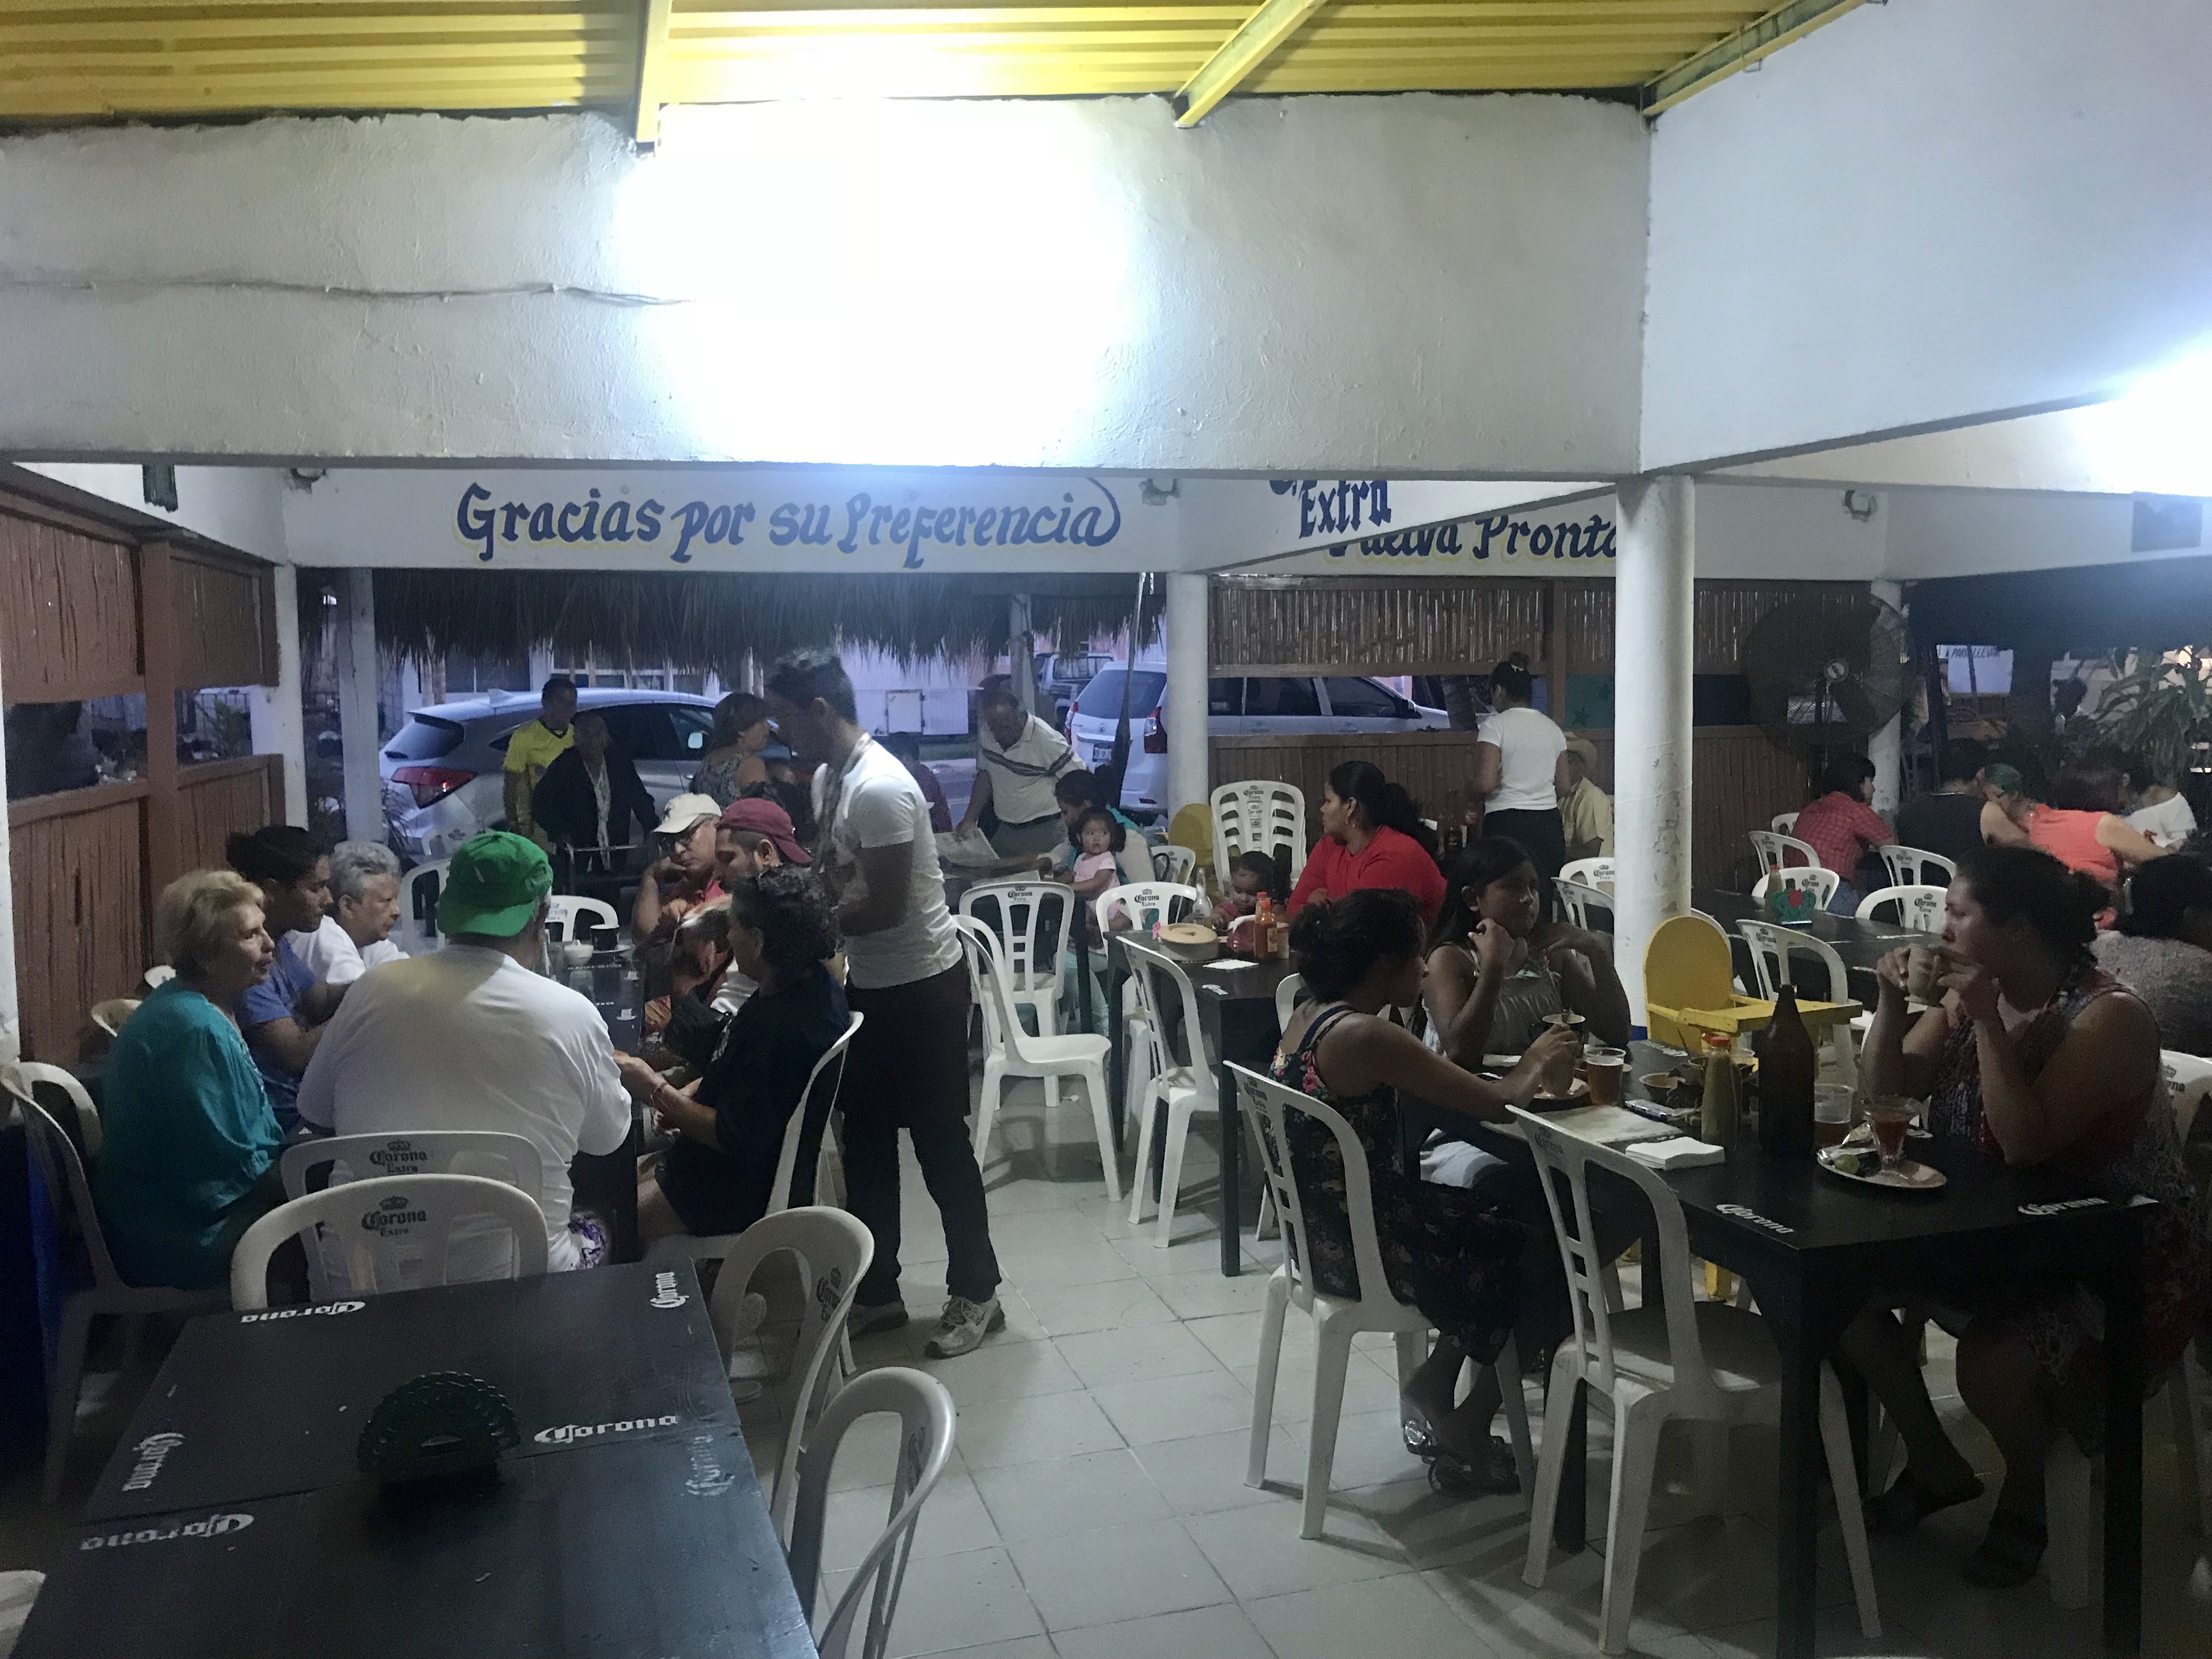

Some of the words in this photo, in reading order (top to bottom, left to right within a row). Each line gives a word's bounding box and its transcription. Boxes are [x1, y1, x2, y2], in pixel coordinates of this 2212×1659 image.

[457, 482, 664, 562] Gracias
[670, 501, 755, 563] por
[769, 503, 832, 546] su
[837, 477, 1121, 568] Preferencia
[1299, 480, 1391, 539] Extra
[1134, 895, 1159, 903] Corona
[1915, 898, 1937, 908] Corona
[369, 1150, 428, 1166] Corona
[387, 1164, 418, 1173] Extra
[362, 1210, 427, 1231] Corona
[1717, 1204, 1795, 1234] Corona
[380, 1227, 409, 1238] Extra
[650, 1271, 690, 1309] Corona
[241, 1301, 366, 1323] Corona
[534, 1414, 680, 1444] Corona
[122, 1432, 186, 1492] Corona
[81, 1513, 255, 1550] Corona
